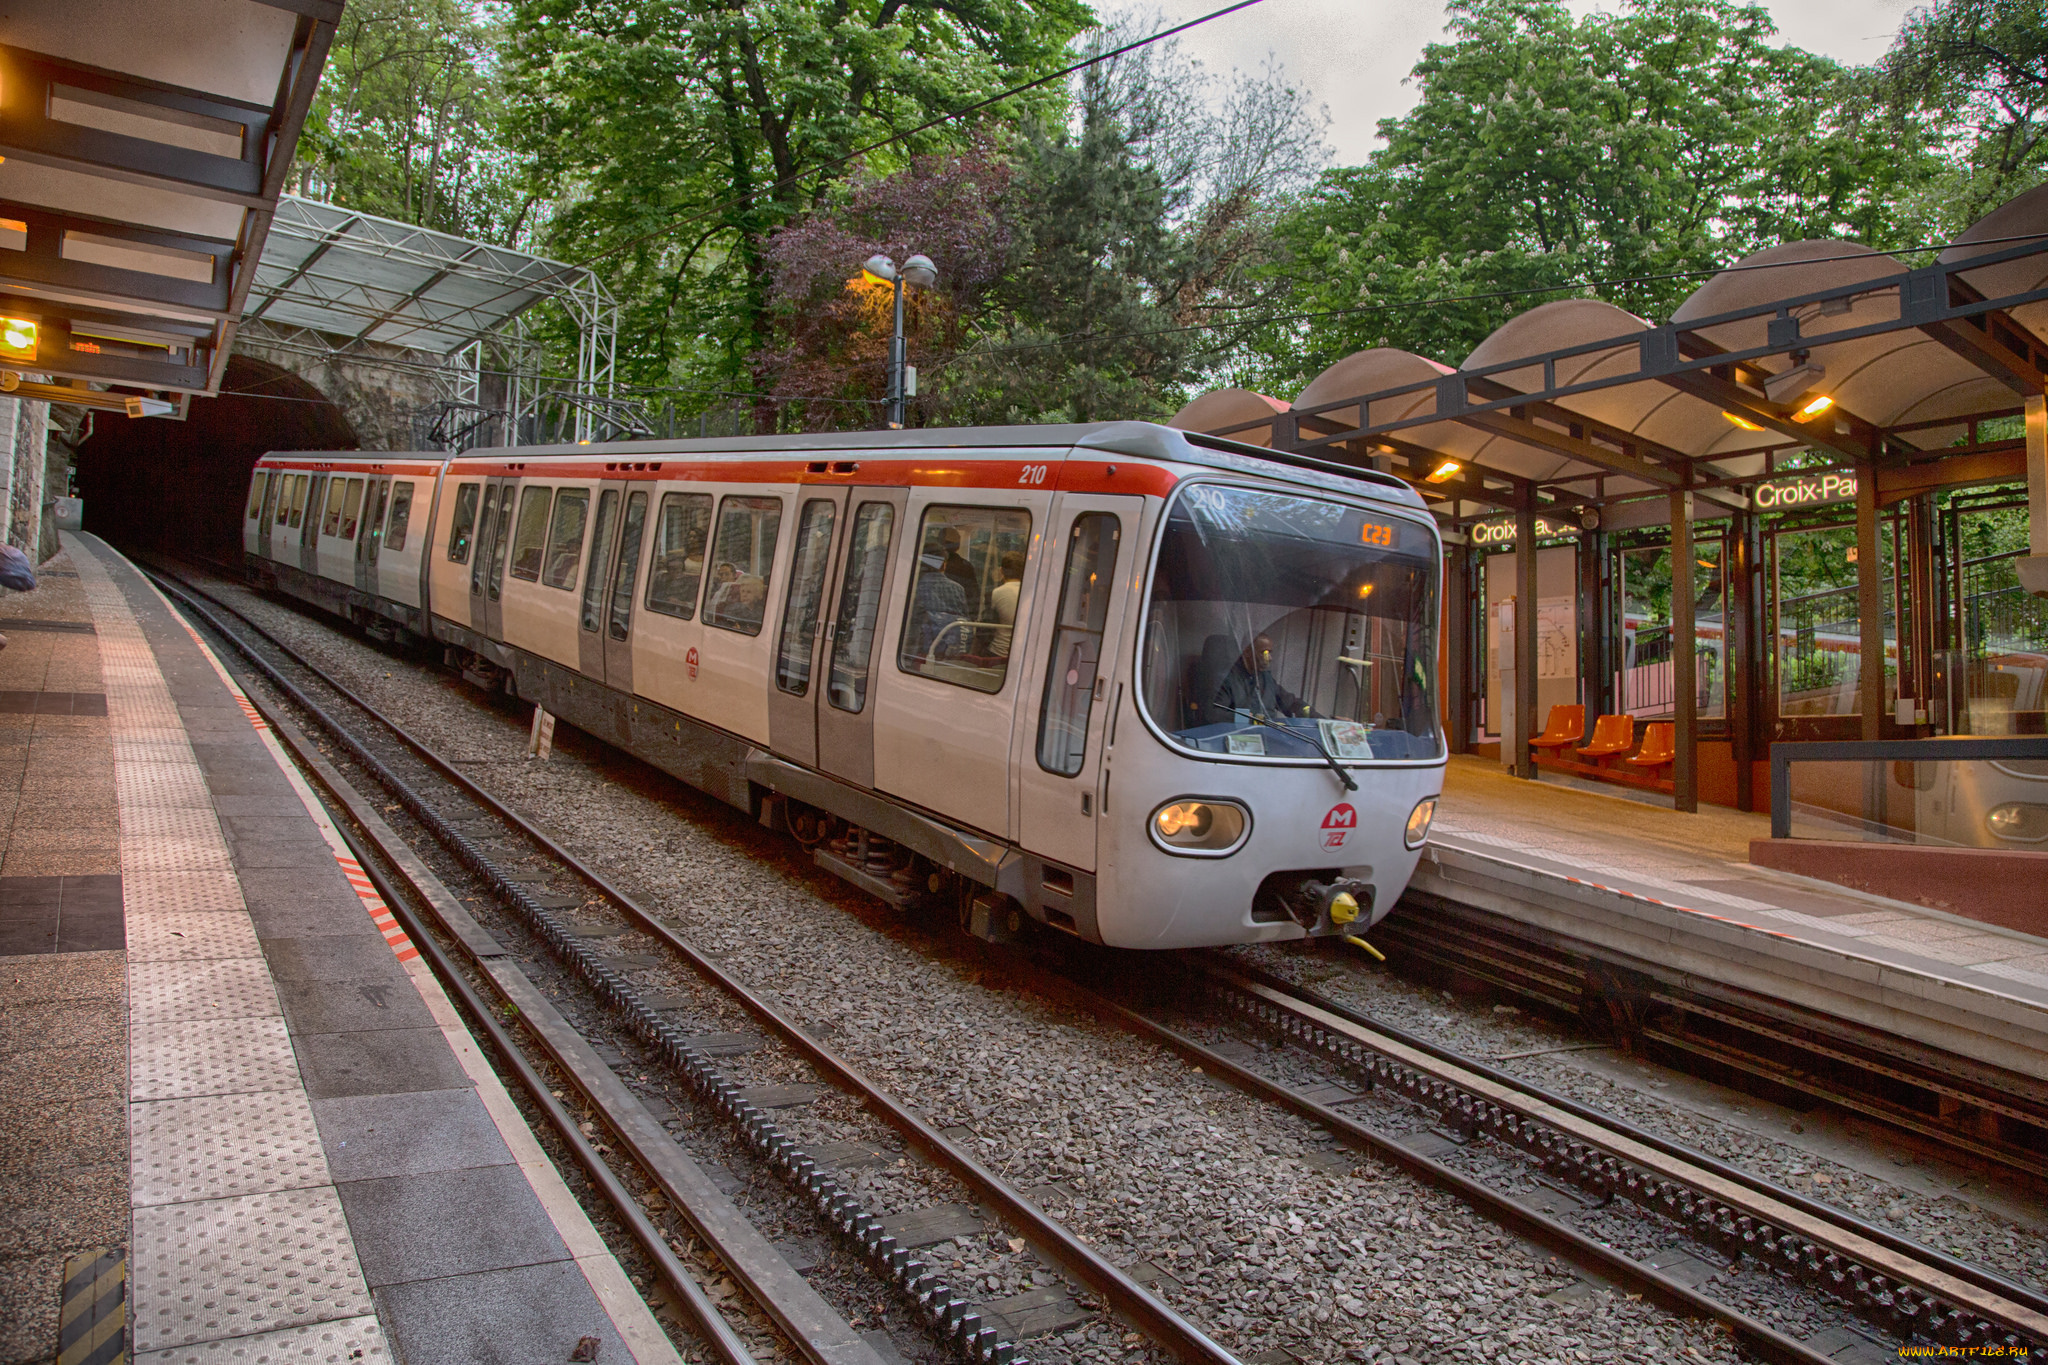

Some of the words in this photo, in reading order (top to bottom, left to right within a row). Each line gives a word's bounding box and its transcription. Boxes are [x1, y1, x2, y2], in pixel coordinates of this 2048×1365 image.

[1018, 465, 1047, 484] 210
[1192, 488, 1225, 510] 210
[1755, 475, 1858, 508] Croix-Pa
[1362, 523, 1391, 546] C23
[1329, 810, 1353, 826] M
